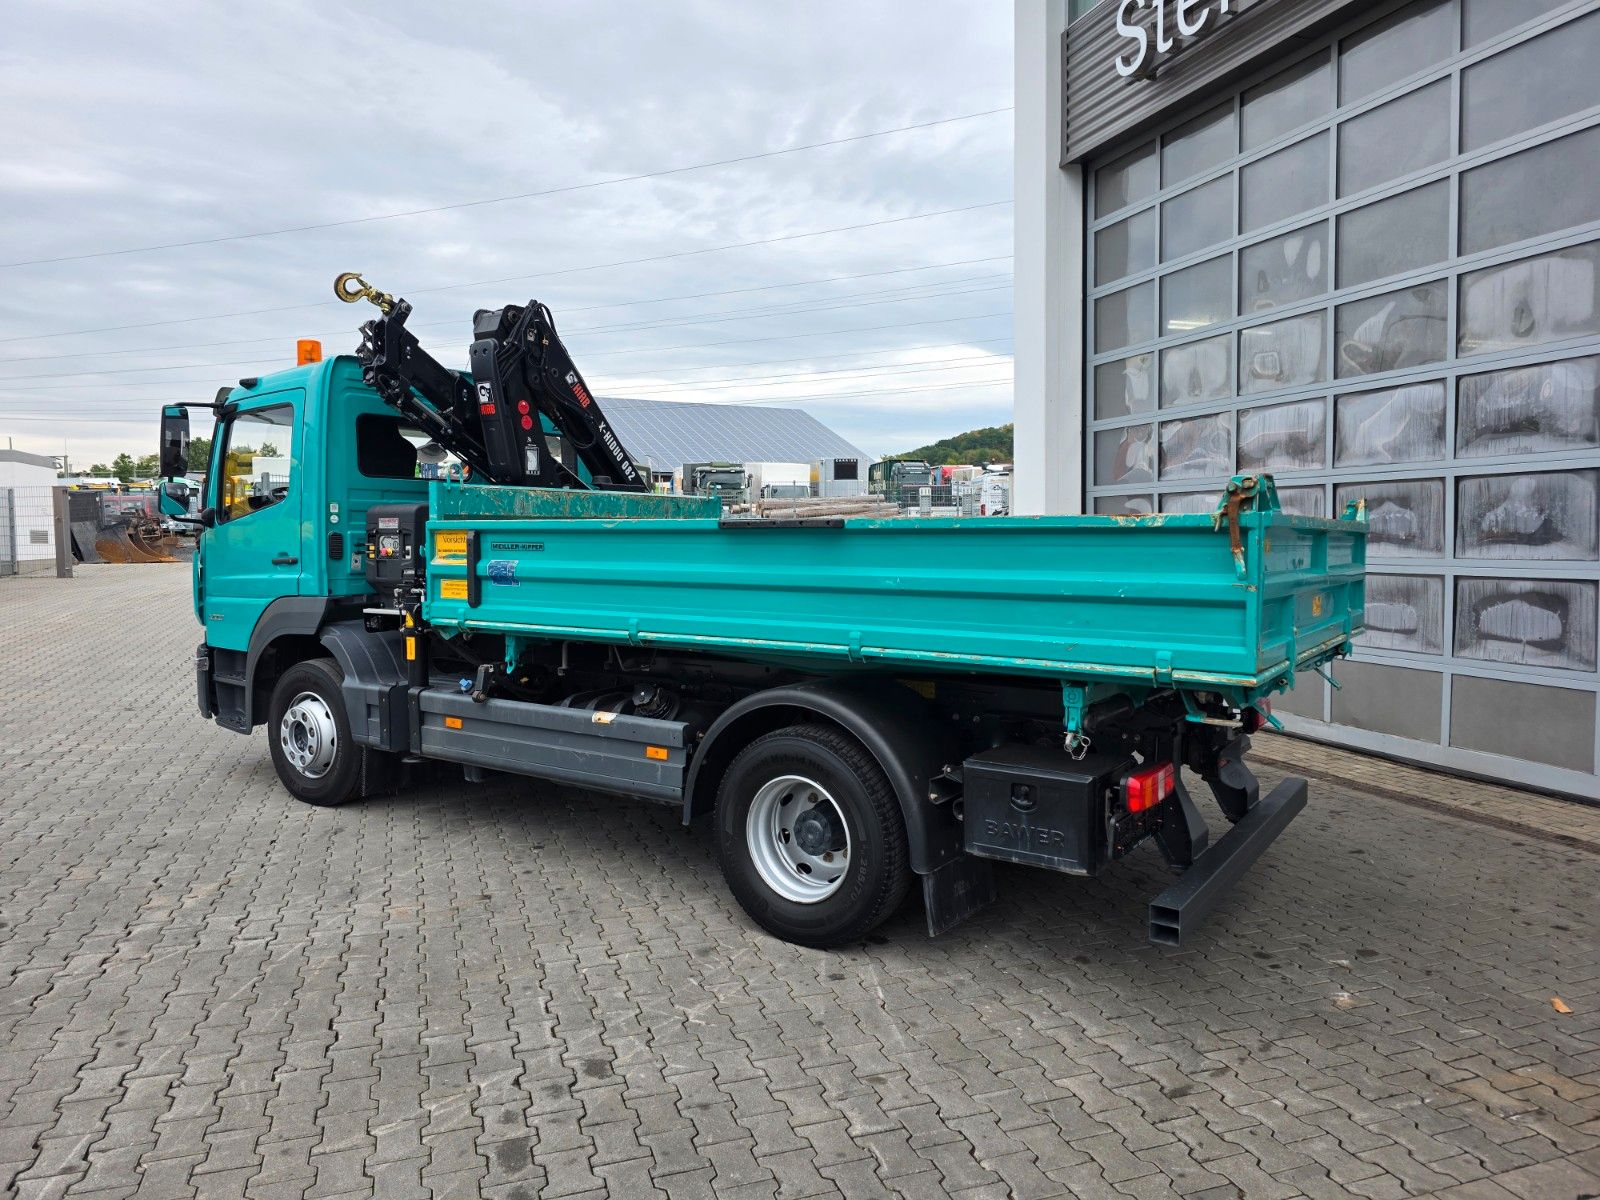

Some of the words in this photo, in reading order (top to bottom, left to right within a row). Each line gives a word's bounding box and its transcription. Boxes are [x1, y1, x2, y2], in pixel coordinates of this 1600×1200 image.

[1115, 0, 1229, 76] Ste
[571, 382, 592, 410] HIAB
[598, 421, 625, 462] X-HIDUO
[621, 460, 637, 481] 082
